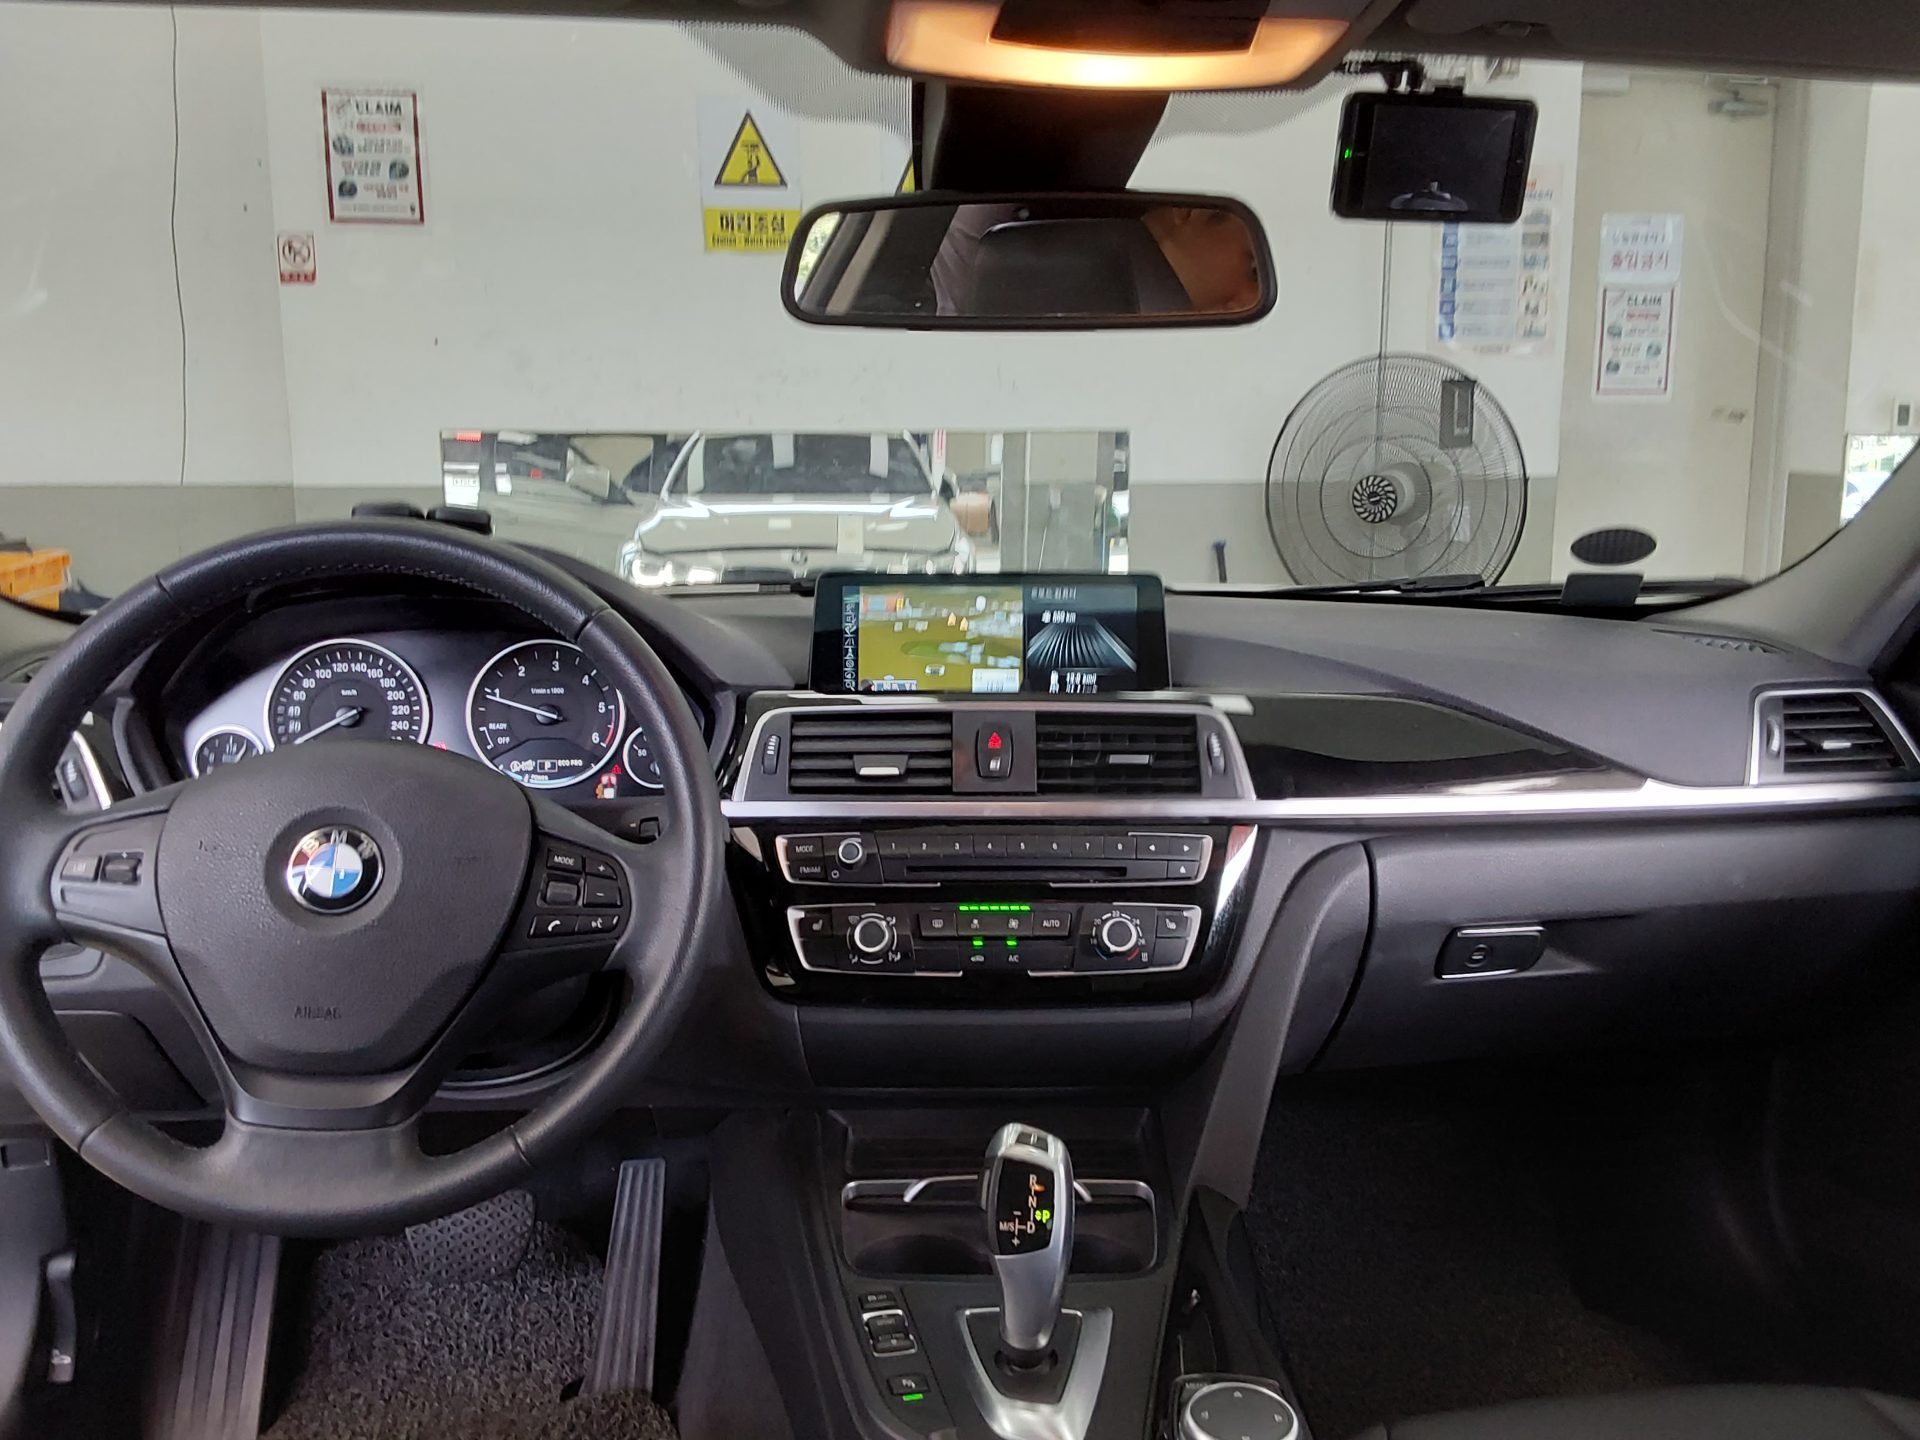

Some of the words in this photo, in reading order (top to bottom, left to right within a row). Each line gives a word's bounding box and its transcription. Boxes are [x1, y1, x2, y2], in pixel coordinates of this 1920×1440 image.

[332, 662, 349, 673] 120
[350, 663, 367, 673] 140
[518, 666, 526, 677] 2
[552, 660, 560, 672] 3
[315, 669, 331, 679] 100
[367, 669, 383, 679] 160
[302, 679, 316, 689] 80
[380, 678, 396, 688] 180
[582, 674, 590, 686] 4
[293, 690, 306, 701] 60
[386, 691, 406, 701] 200
[494, 688, 500, 699] 1
[391, 705, 410, 716] 220
[599, 702, 606, 714] 5
[390, 720, 410, 731] 240
[497, 737, 510, 745] OFF
[592, 733, 600, 745] 6
[637, 750, 647, 758] 50
[795, 845, 814, 853] MODE
[891, 842, 896, 850] 1
[554, 855, 575, 866] MODE
[1042, 919, 1060, 928] AUTO
[1029, 1173, 1038, 1189] R
[1028, 1195, 1037, 1209] N
[1042, 1209, 1051, 1224] P
[999, 1221, 1015, 1232] M/S
[1026, 1221, 1036, 1234] D
